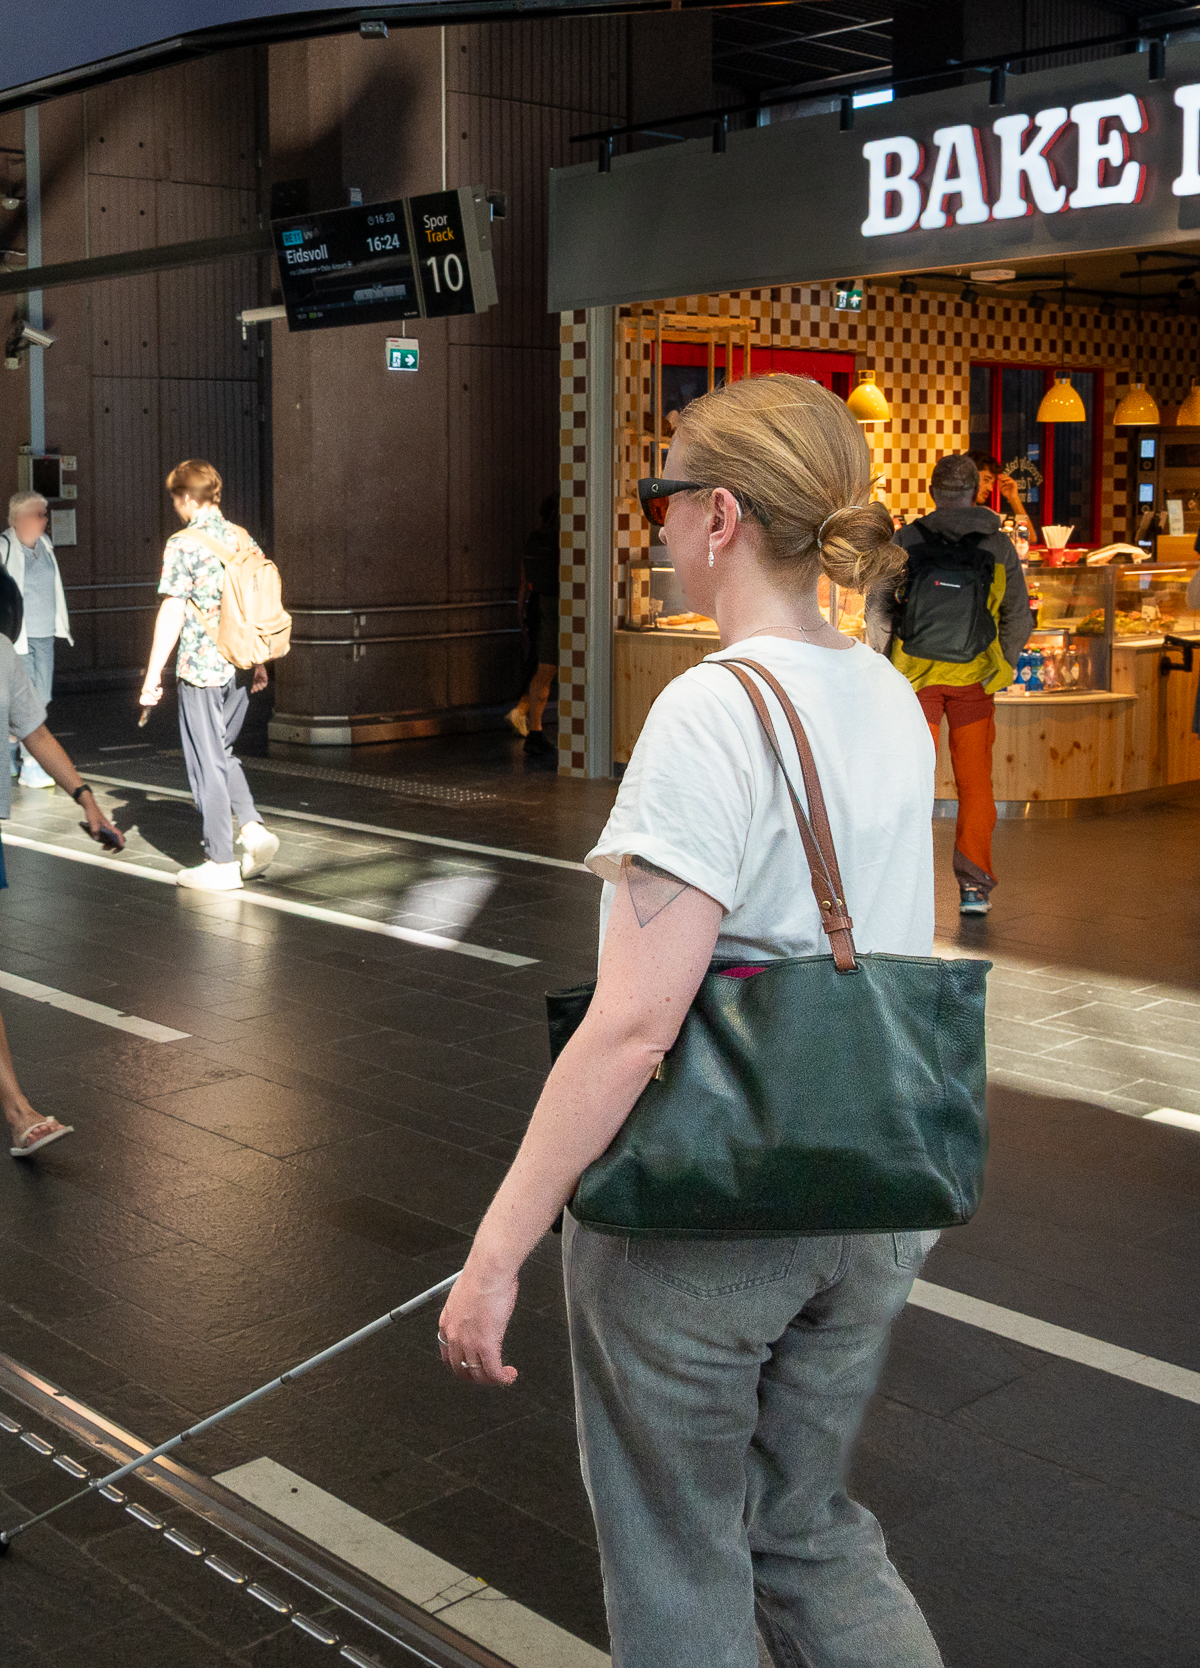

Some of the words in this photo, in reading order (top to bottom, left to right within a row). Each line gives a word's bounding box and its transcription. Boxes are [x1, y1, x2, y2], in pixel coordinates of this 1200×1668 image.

[861, 93, 1148, 238] BAKE
[423, 214, 448, 230] Spor
[366, 233, 401, 252] 16:24
[425, 227, 455, 243] Track
[285, 244, 329, 265] Eidsvoll
[426, 253, 464, 293] 10
